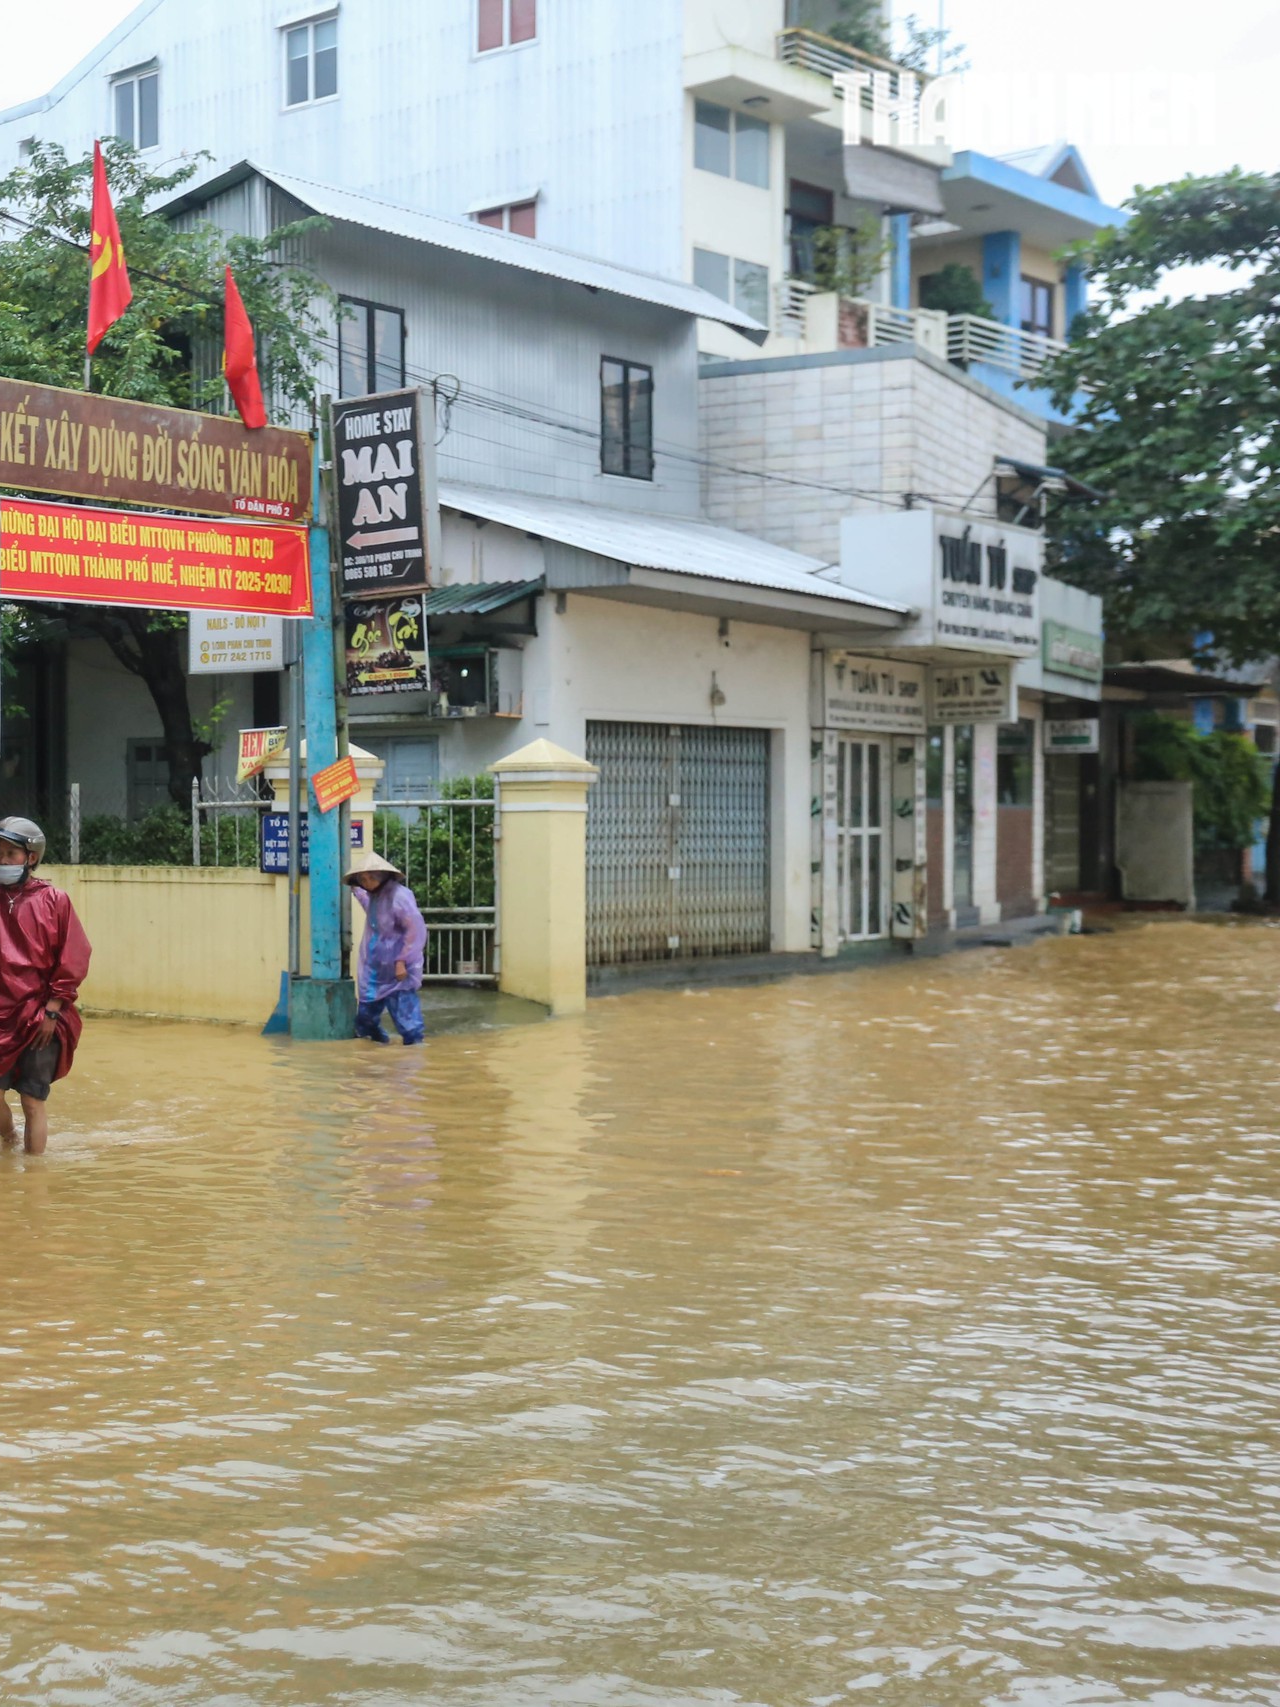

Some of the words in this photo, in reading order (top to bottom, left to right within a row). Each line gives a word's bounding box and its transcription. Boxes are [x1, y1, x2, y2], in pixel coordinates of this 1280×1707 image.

[345, 412, 381, 440] HOME
[383, 407, 412, 434] STAY
[0, 394, 39, 466] KẾT
[44, 410, 83, 472] XÂY
[88, 418, 138, 487] DỰNG
[142, 424, 172, 485] ĐỜI
[177, 423, 225, 493] SỐNG
[230, 442, 262, 497] VĂN
[268, 447, 298, 504] HÓA
[341, 439, 415, 486] MAI
[265, 501, 283, 516] PHỐ
[284, 508, 290, 517] 2
[352, 482, 408, 526] AN
[38, 515, 59, 543] ĐẠI
[62, 514, 83, 545] HỘI
[86, 519, 106, 547] ĐẠI
[110, 516, 137, 546] BIỂU
[140, 525, 185, 551] MTTQVN
[188, 528, 232, 556] PHƯỜNG
[235, 536, 250, 557] AN
[253, 537, 274, 563] CỰU
[0, 540, 27, 572] BIỂU
[30, 551, 80, 578] MTTQVN
[83, 552, 122, 580] THÀNH
[125, 554, 148, 583] PHỐ
[151, 556, 177, 587] HUẾ,
[180, 561, 216, 592] NHIỆM
[218, 564, 232, 590] KỲ
[235, 570, 292, 595] 2025-2030!
[207, 618, 227, 630] NAILS
[211, 653, 228, 663] 077
[231, 652, 247, 662] 242
[250, 651, 272, 660] 1715
